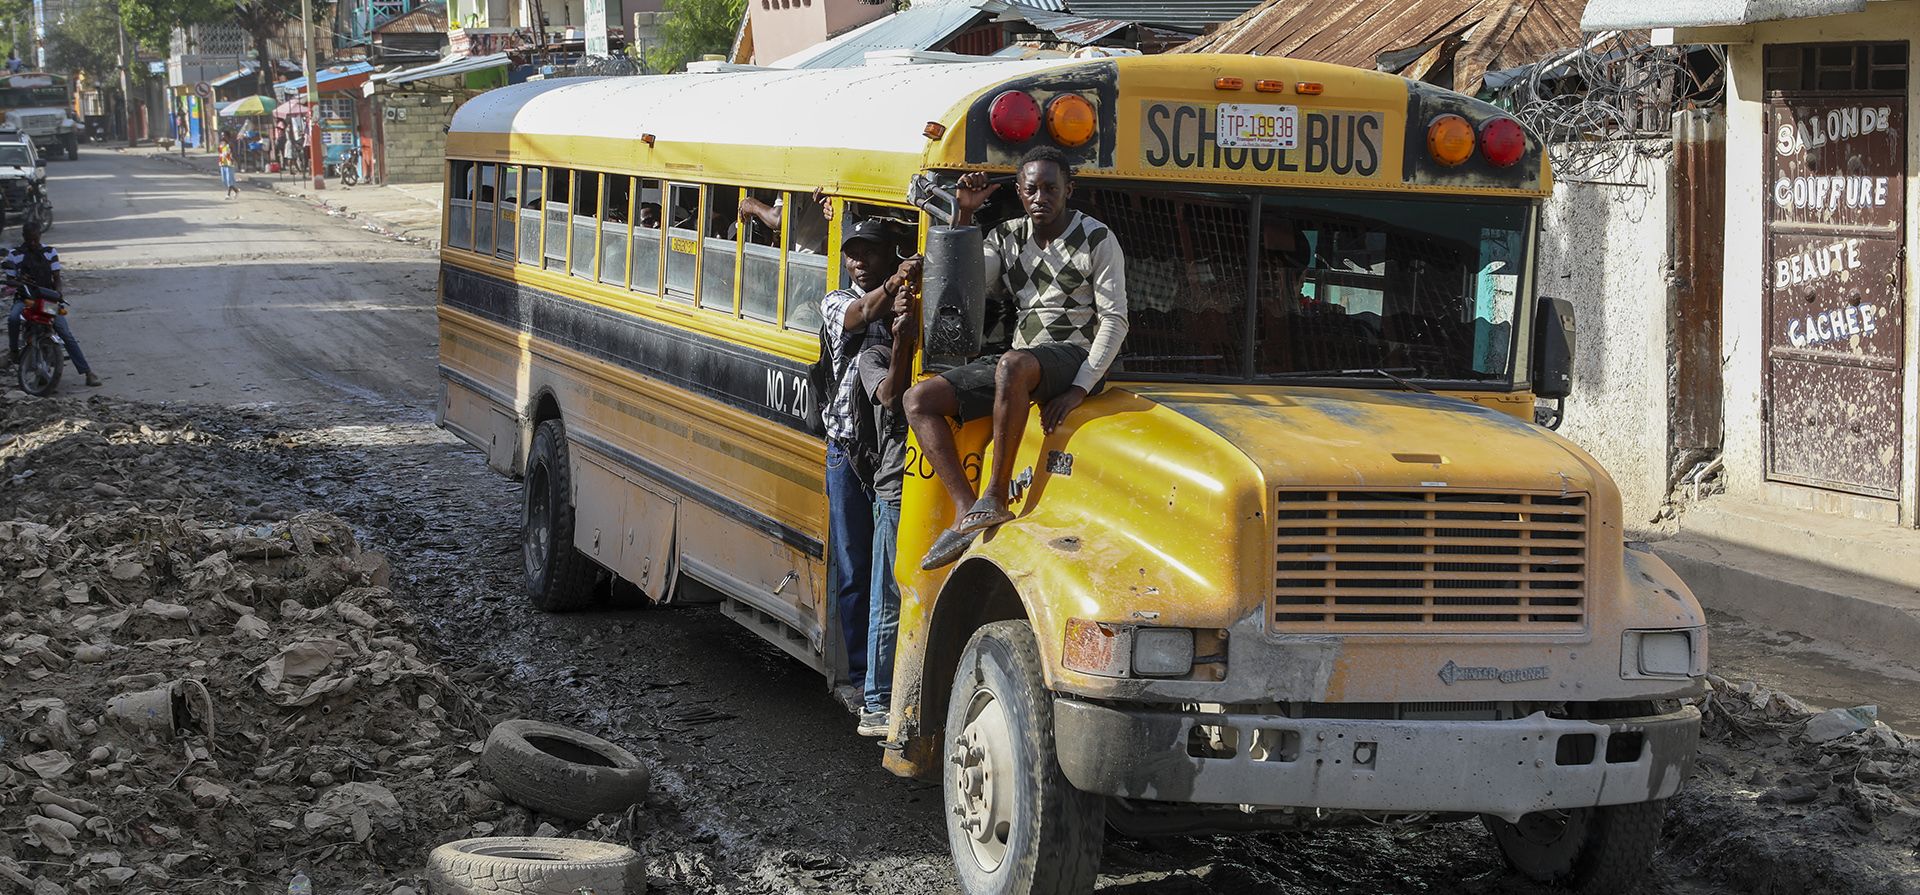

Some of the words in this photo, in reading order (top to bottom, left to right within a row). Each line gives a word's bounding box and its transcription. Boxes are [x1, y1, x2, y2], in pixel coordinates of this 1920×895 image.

[1304, 113, 1378, 177] BUS
[1775, 176, 1889, 211] COIFFURE
[1775, 238, 1861, 290] BEAUTE
[1788, 302, 1876, 347] CACHEE
[766, 368, 787, 413] NO.
[792, 376, 809, 420] 20
[904, 445, 981, 483] 206
